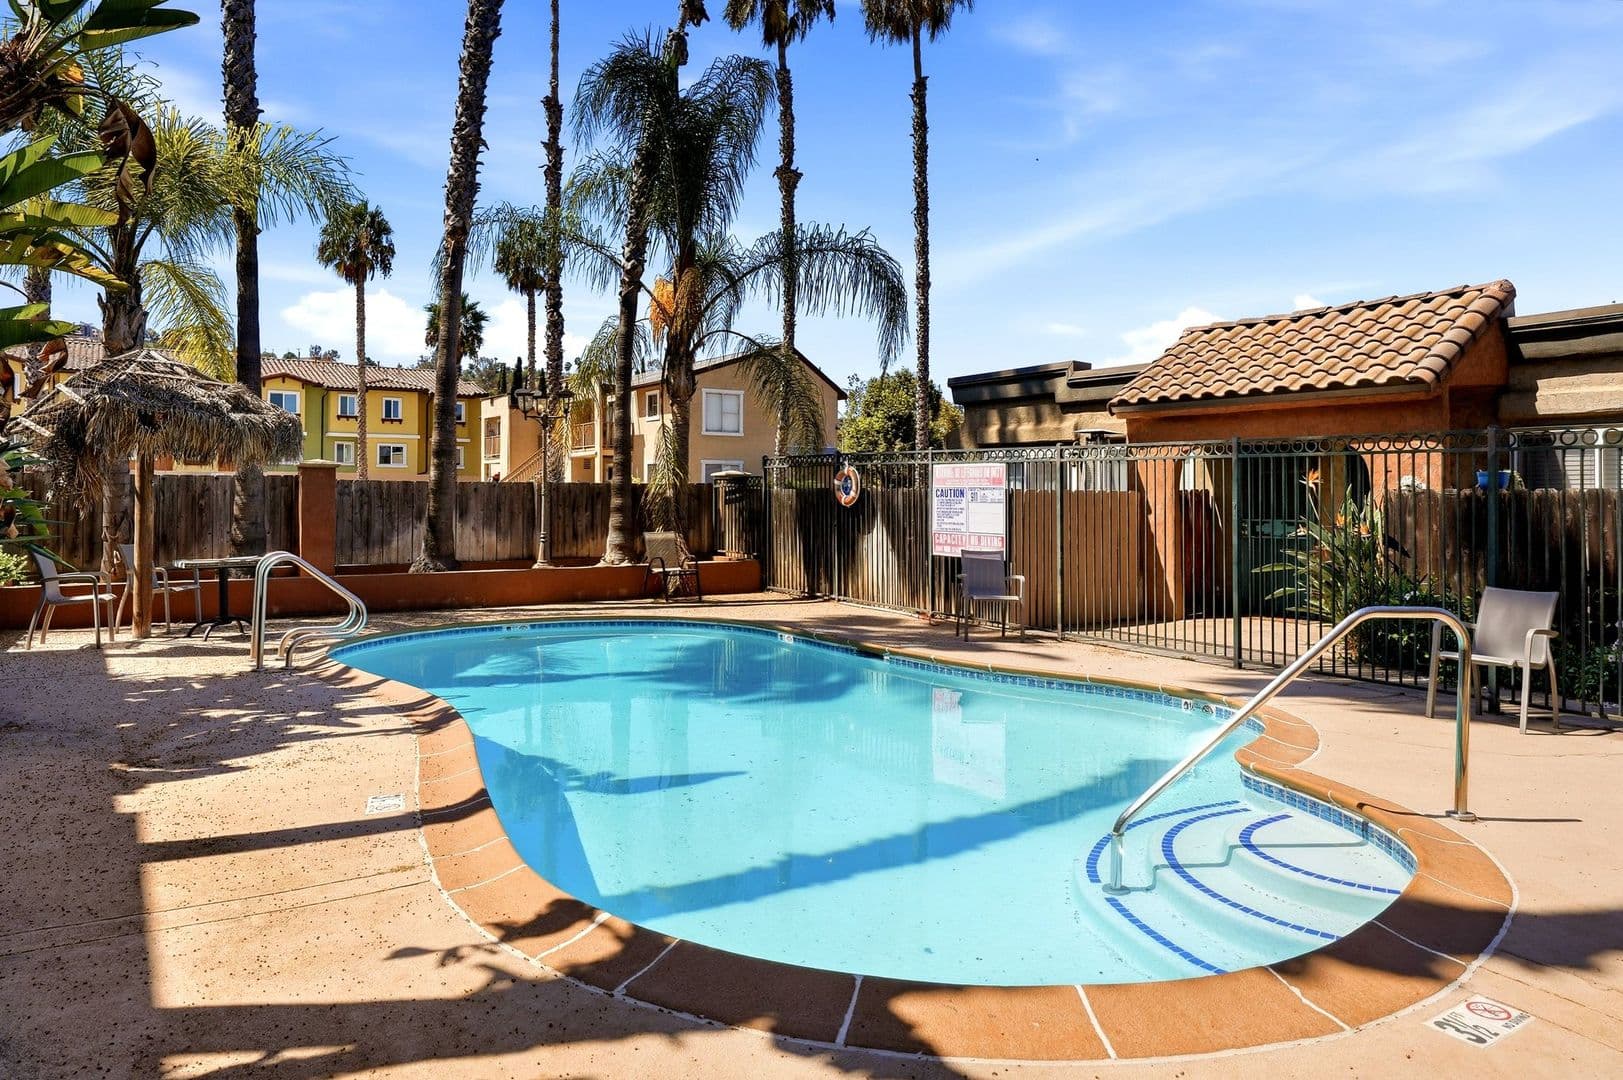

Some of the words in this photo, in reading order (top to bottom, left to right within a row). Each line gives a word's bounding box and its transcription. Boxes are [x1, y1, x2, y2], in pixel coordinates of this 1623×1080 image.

[935, 488, 965, 498] CAUTION
[935, 533, 966, 545] CAPACITY
[980, 536, 1002, 547] DIVING
